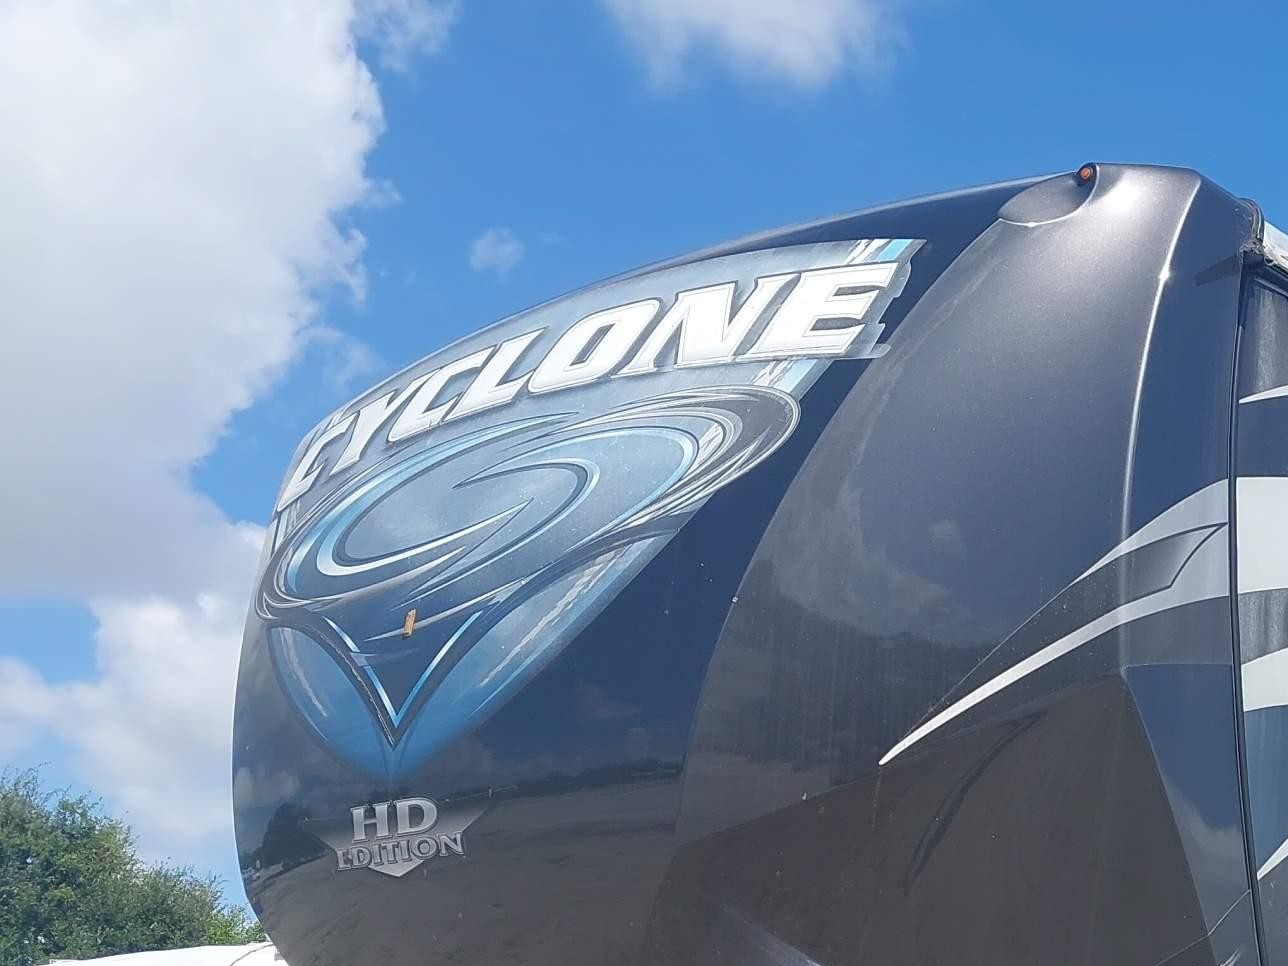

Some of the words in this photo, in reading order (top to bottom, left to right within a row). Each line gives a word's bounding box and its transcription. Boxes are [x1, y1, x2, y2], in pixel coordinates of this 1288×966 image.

[276, 260, 902, 514] CYCLONE
[350, 796, 438, 843] HD
[335, 831, 466, 872] EDITION
